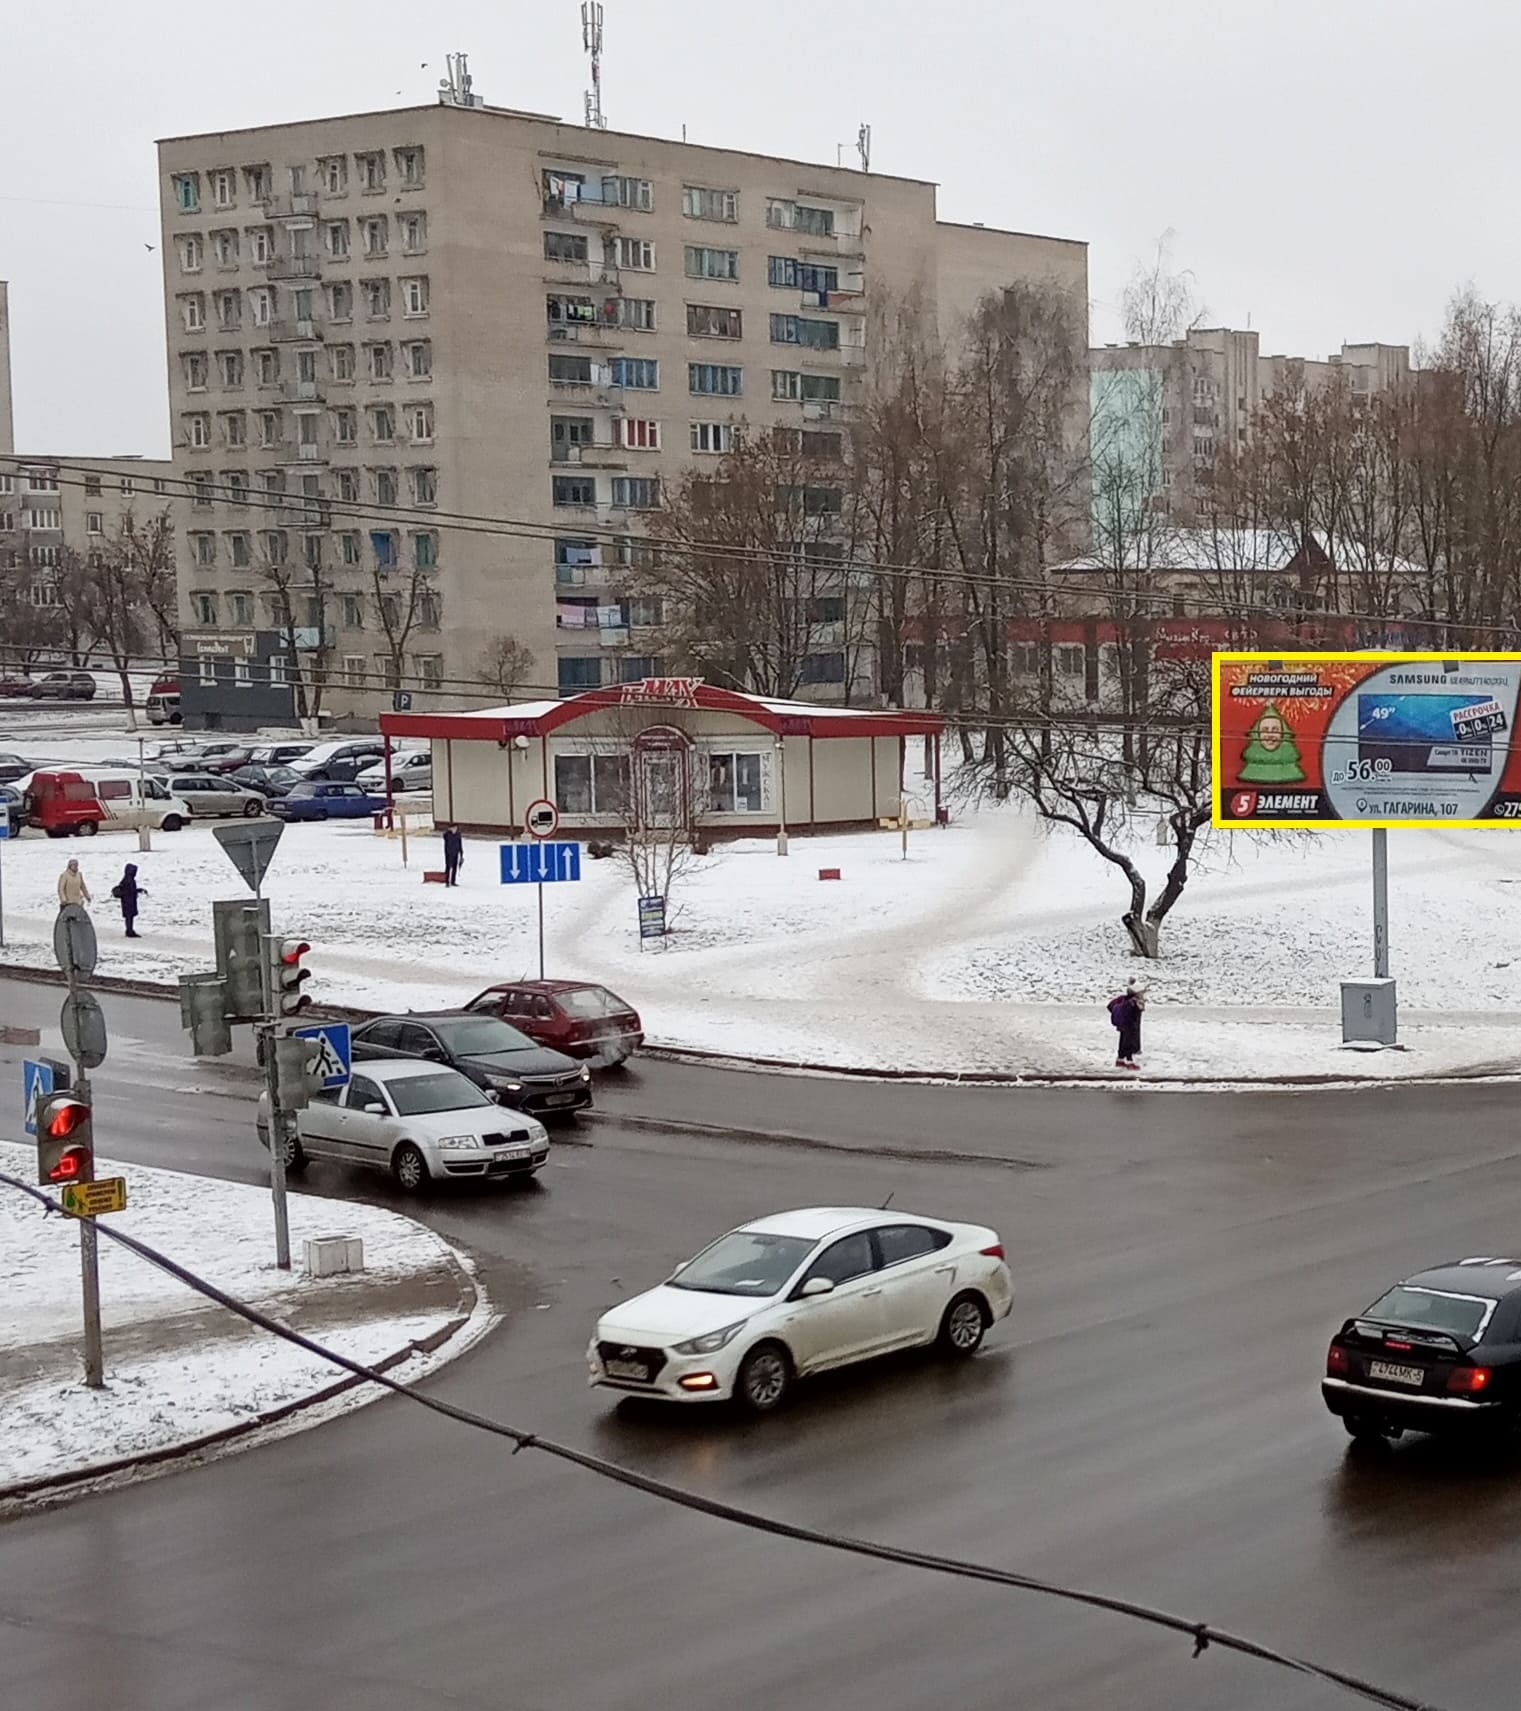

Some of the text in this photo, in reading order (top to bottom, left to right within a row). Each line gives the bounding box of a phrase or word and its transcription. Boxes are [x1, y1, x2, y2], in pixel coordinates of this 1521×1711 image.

[1249, 674, 1318, 685] НОВОГОДНИЙ
[1389, 674, 1447, 685] SAMSUNG
[1231, 685, 1333, 698] ФЕЙЕРВЕРК ВЫГОДЫ
[1453, 701, 1500, 721] РАССРОЧКА
[1489, 713, 1503, 727] 24
[1237, 794, 1319, 813] 5 ЭЛЕМЕНТ
[1369, 802, 1458, 816] ул. ГАГАРИНА, 107
